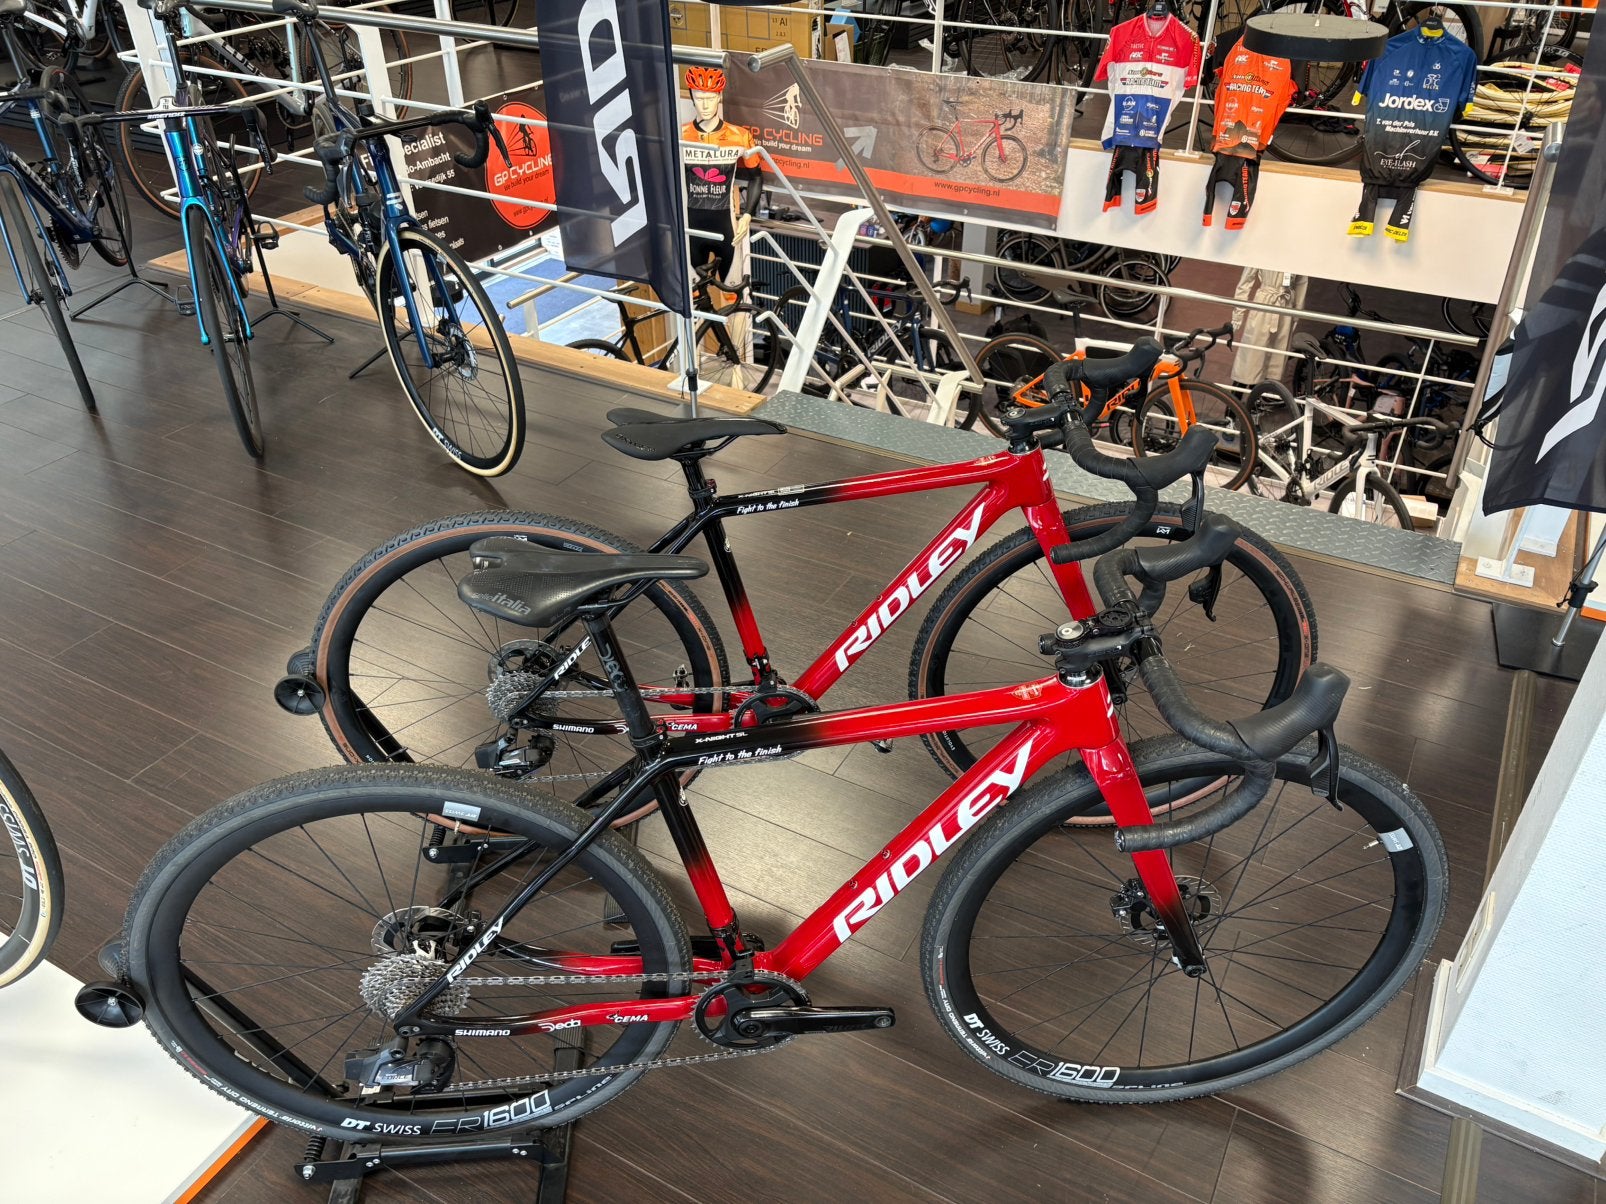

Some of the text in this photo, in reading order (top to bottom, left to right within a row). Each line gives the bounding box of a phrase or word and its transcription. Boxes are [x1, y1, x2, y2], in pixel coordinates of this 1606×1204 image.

[1378, 92, 1434, 112] Jordex
[402, 132, 446, 157] ecialist
[762, 139, 778, 147] build
[778, 142, 790, 150] your
[791, 144, 812, 152] dream
[764, 127, 823, 146] CYCLING
[685, 150, 740, 158] METALURA
[446, 169, 456, 179] 55
[493, 171, 510, 186] GP
[690, 184, 727, 194] BONNE FLEUR
[934, 180, 1000, 198] www.gpcycling.nl
[427, 216, 449, 229] fietsen
[432, 427, 463, 460] DT SWISS
[736, 504, 756, 515] Fight
[766, 502, 777, 510] the
[778, 499, 799, 508] finish
[834, 502, 986, 672] RIDLEY
[493, 592, 532, 616] italia
[554, 636, 593, 680] RIDLE
[552, 724, 595, 734] SHIMANO
[672, 723, 698, 731] CEMA
[695, 734, 734, 744] X-NIGHT
[698, 745, 782, 766] Fight to the finish
[1, 803, 30, 859] SWISS
[832, 739, 1034, 944] RIDLEY
[22, 865, 38, 890] DT
[447, 916, 504, 984] RIDLEY
[454, 1014, 649, 1037] SHIMANO Deda CEMA
[963, 1012, 983, 1030] DT
[977, 1028, 1010, 1056] SWISS
[340, 1117, 371, 1132] DT
[372, 1122, 422, 1136] SWISS
